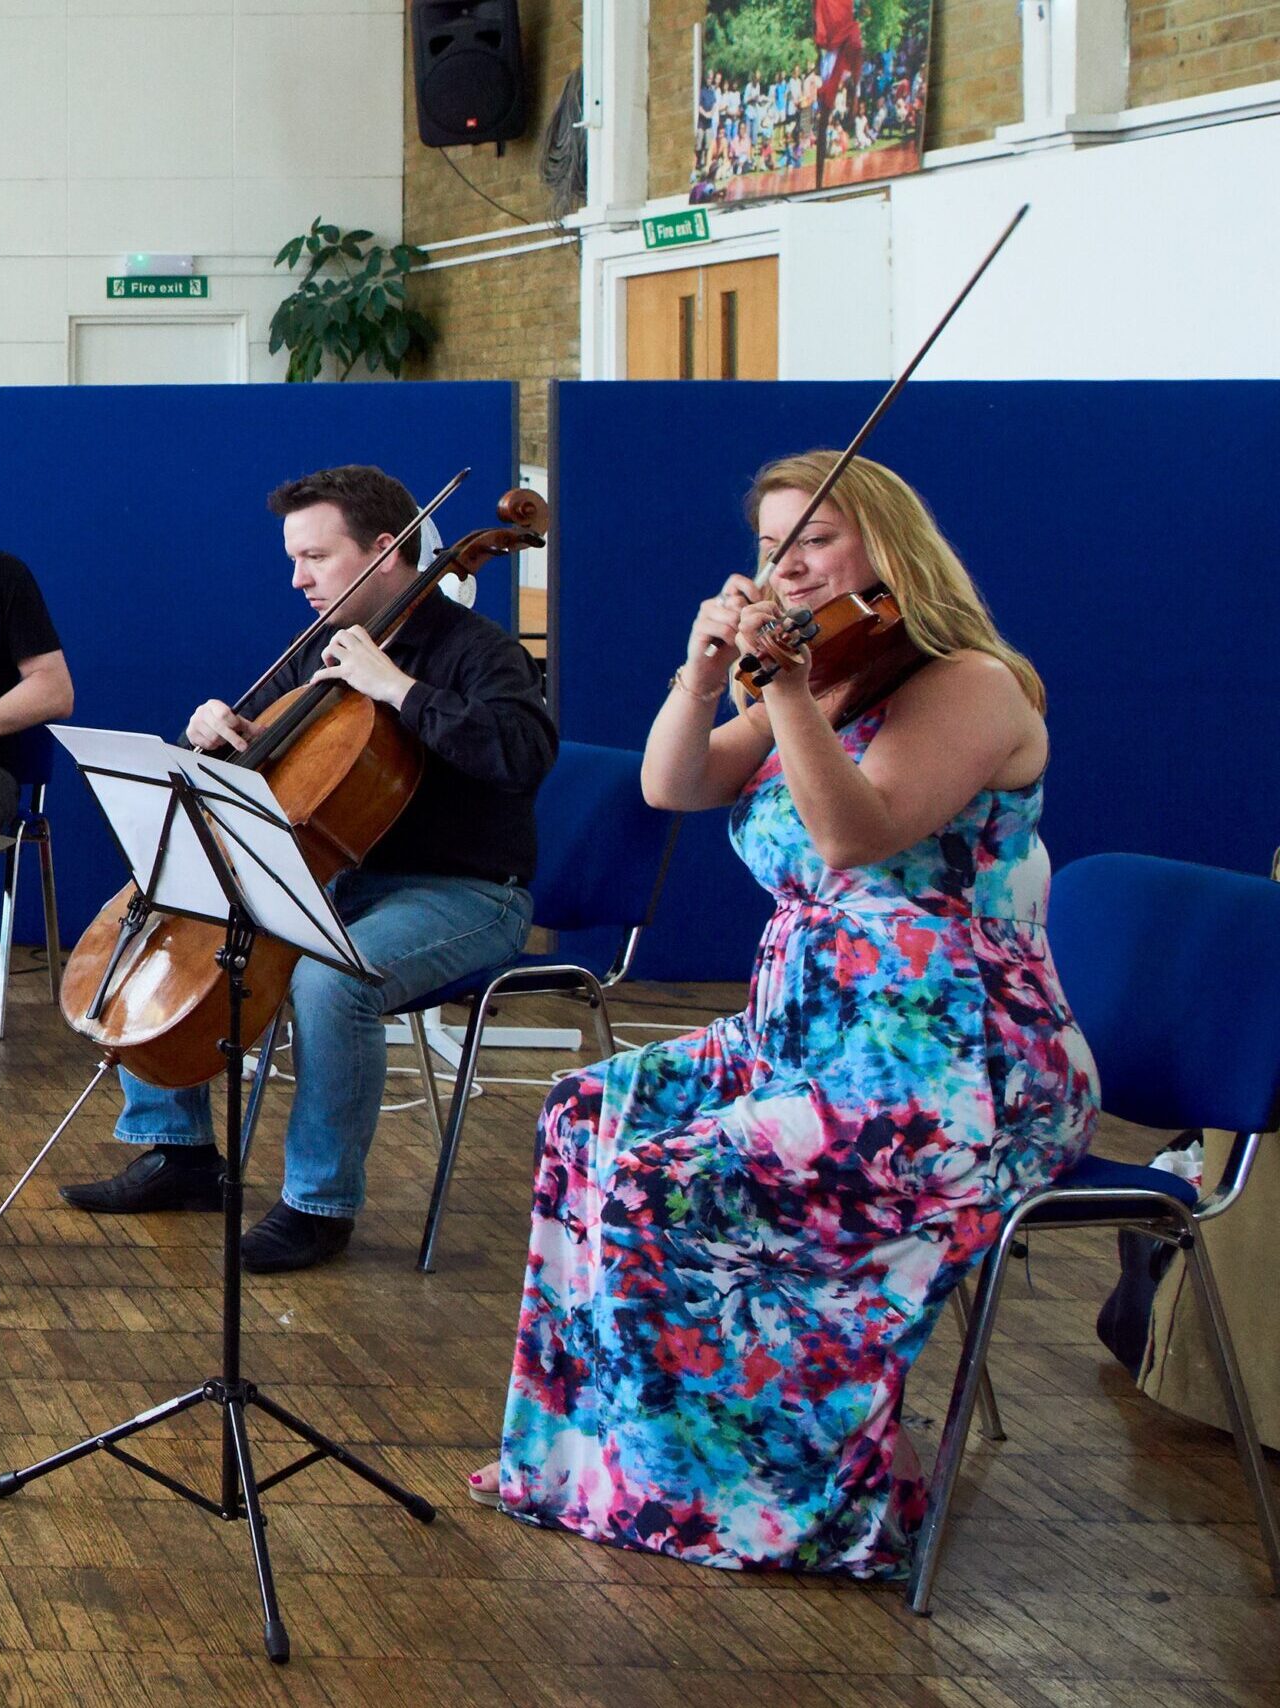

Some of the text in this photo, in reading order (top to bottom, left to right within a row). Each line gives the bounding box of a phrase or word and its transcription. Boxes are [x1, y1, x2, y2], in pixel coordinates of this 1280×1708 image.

[657, 219, 693, 239] Fire exit
[131, 282, 183, 293] Fire exit
